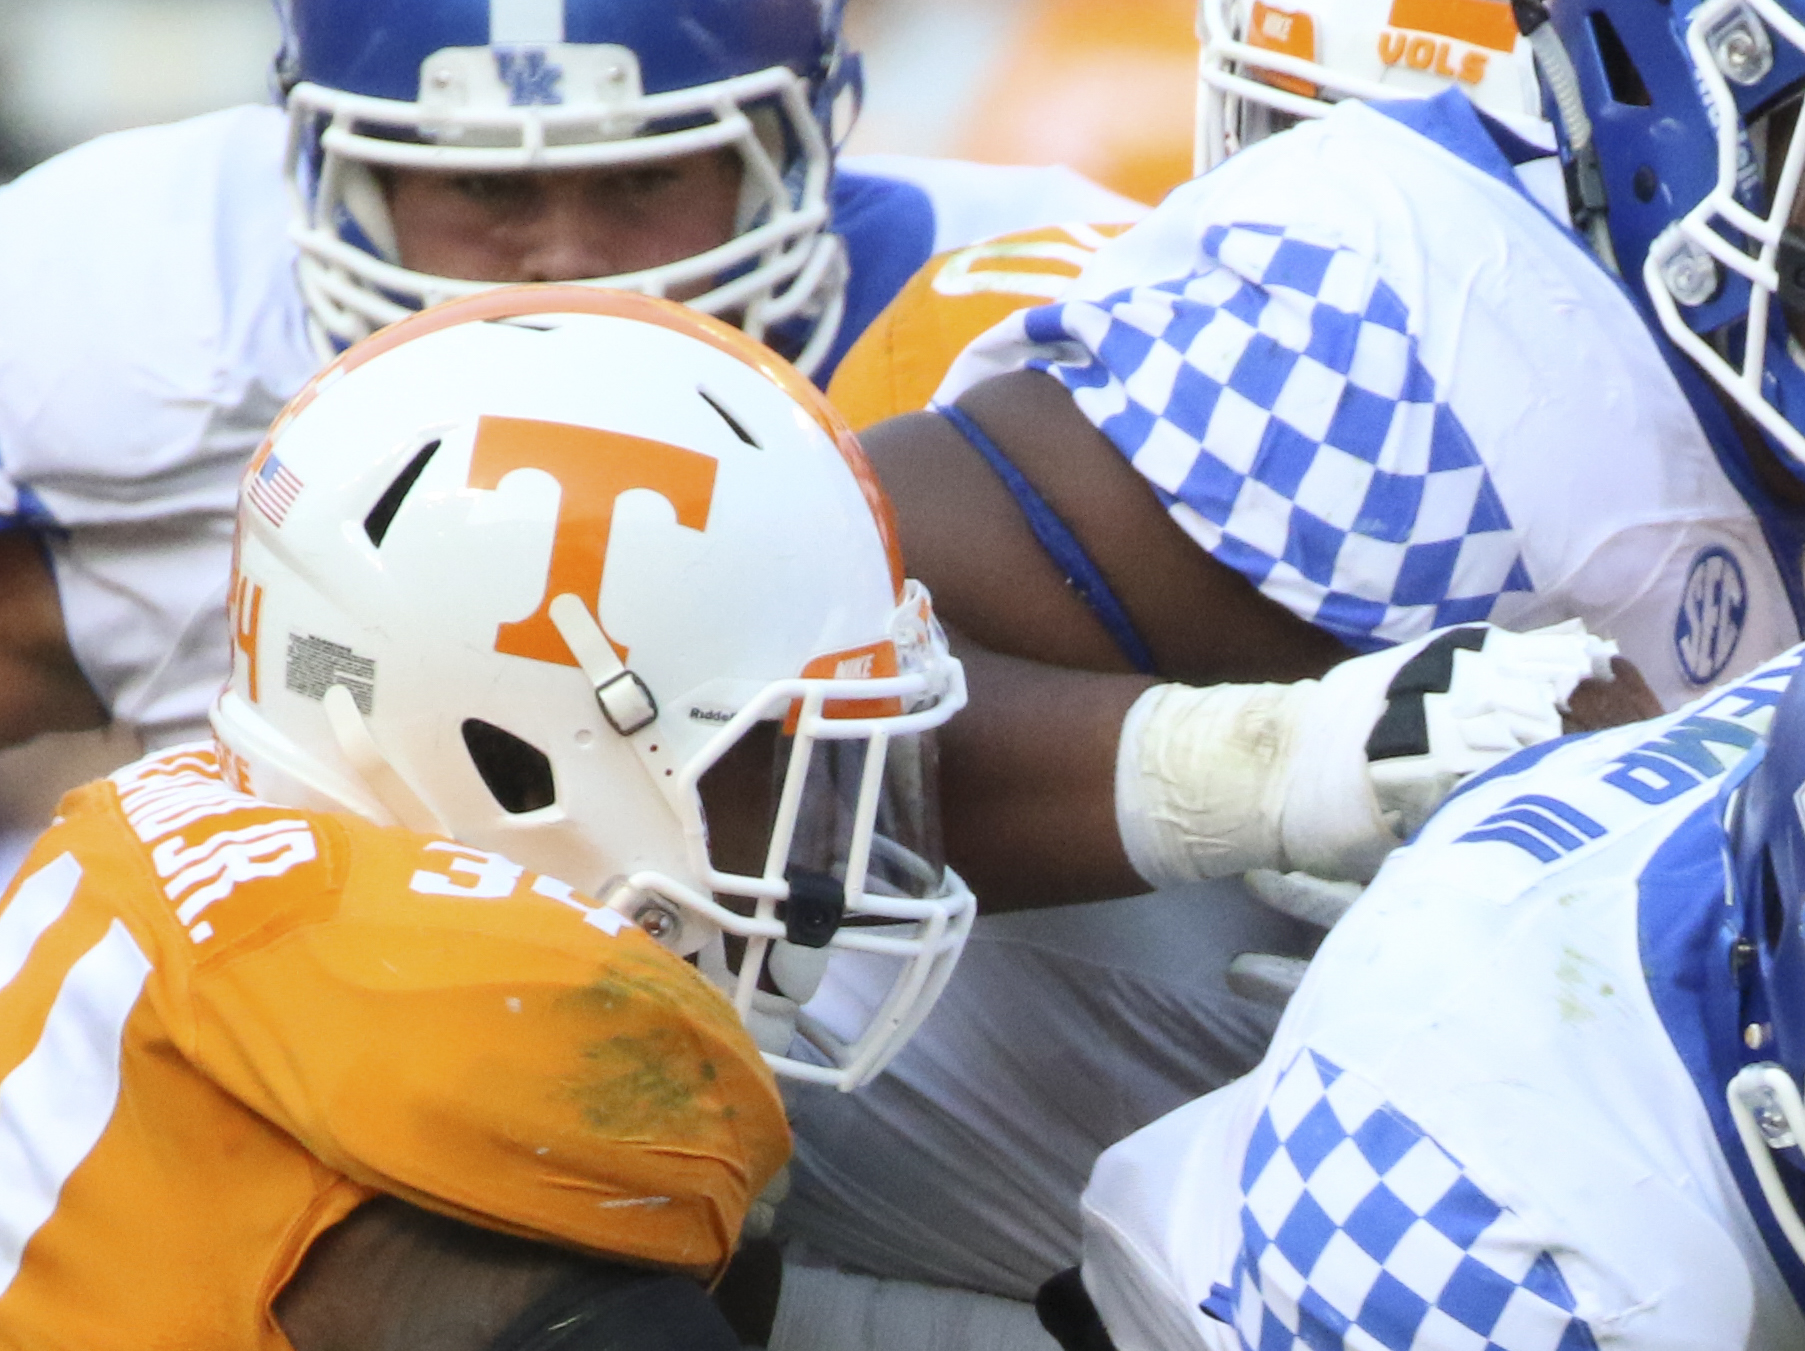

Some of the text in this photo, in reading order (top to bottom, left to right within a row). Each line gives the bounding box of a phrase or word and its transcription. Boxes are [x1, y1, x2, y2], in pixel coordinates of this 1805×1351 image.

[1377, 32, 1489, 85] VOLS
[466, 414, 719, 669] T
[1680, 556, 1744, 676] SEC
[152, 818, 318, 944] JR.
